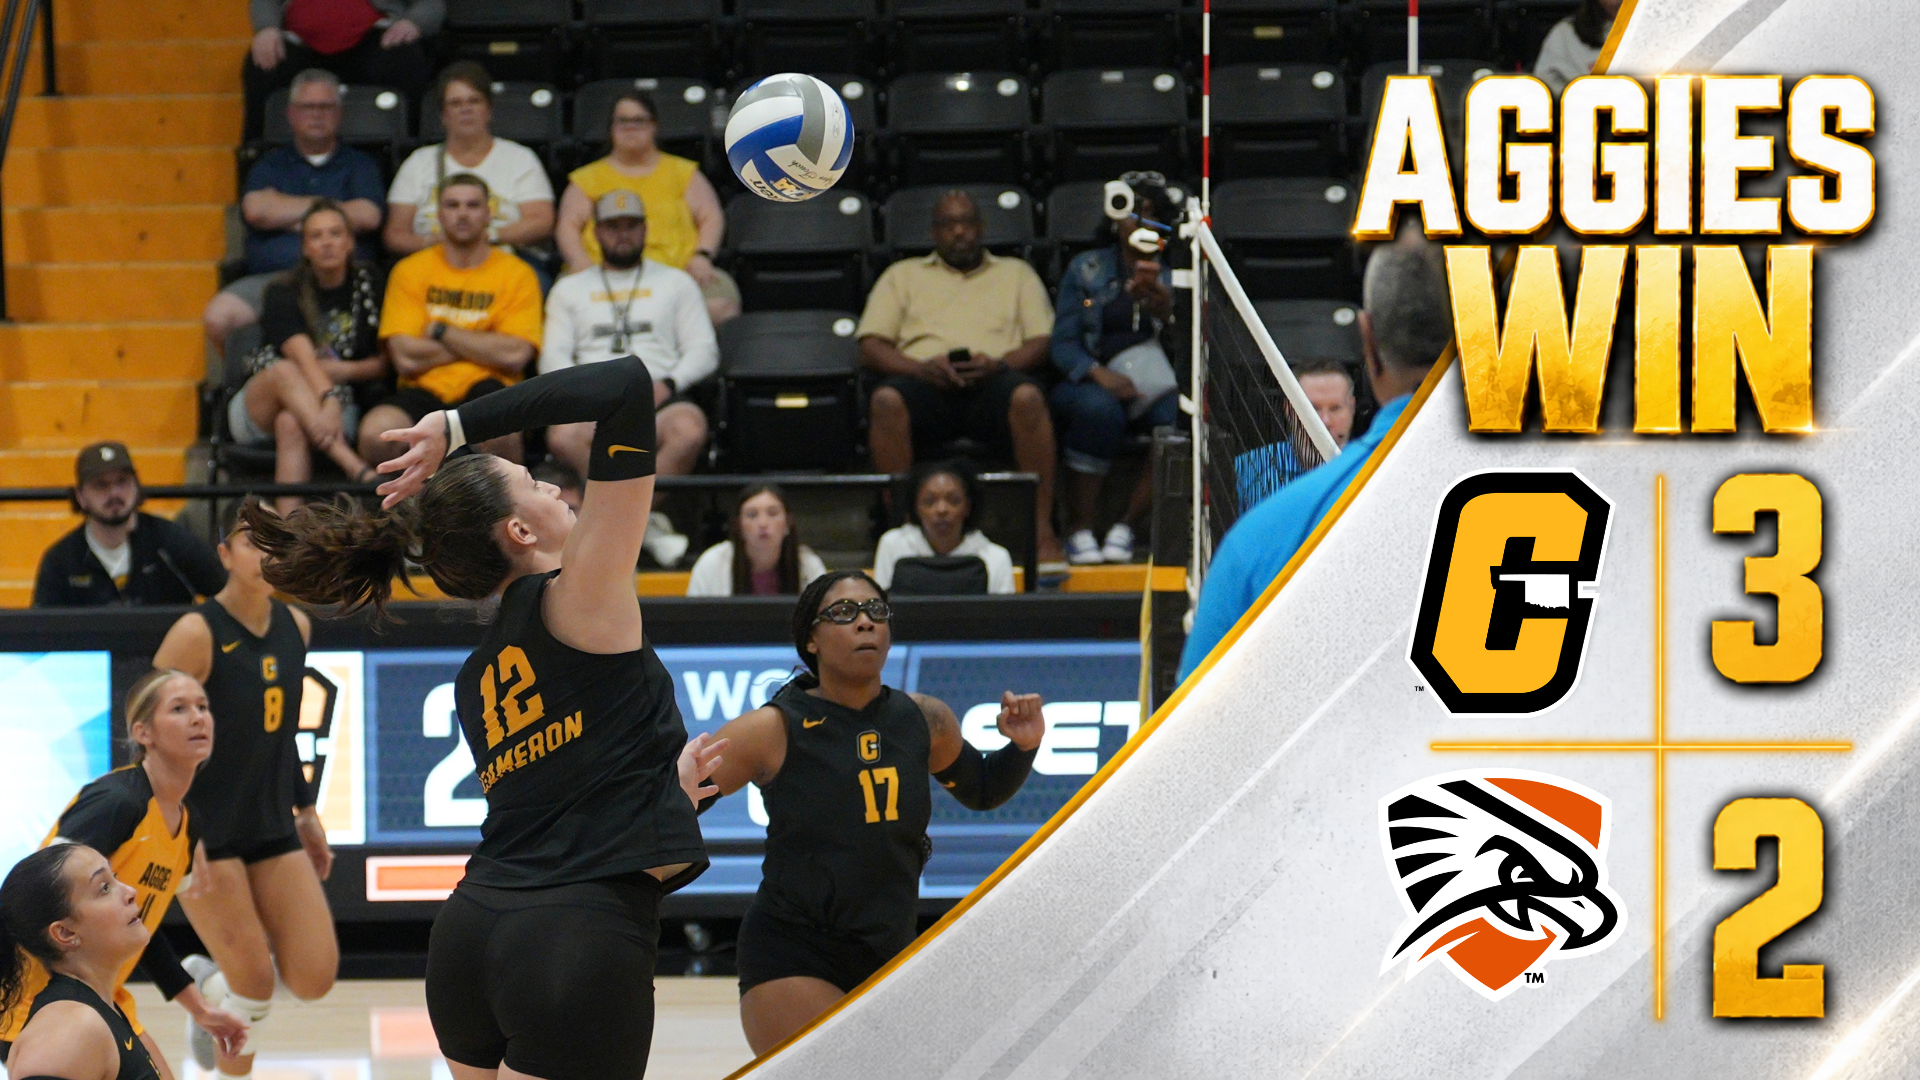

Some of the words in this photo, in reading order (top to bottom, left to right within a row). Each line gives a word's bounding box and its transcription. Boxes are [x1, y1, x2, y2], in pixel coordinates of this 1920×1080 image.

[263, 686, 284, 733] 8
[480, 645, 545, 751] 12
[858, 767, 899, 824] 17
